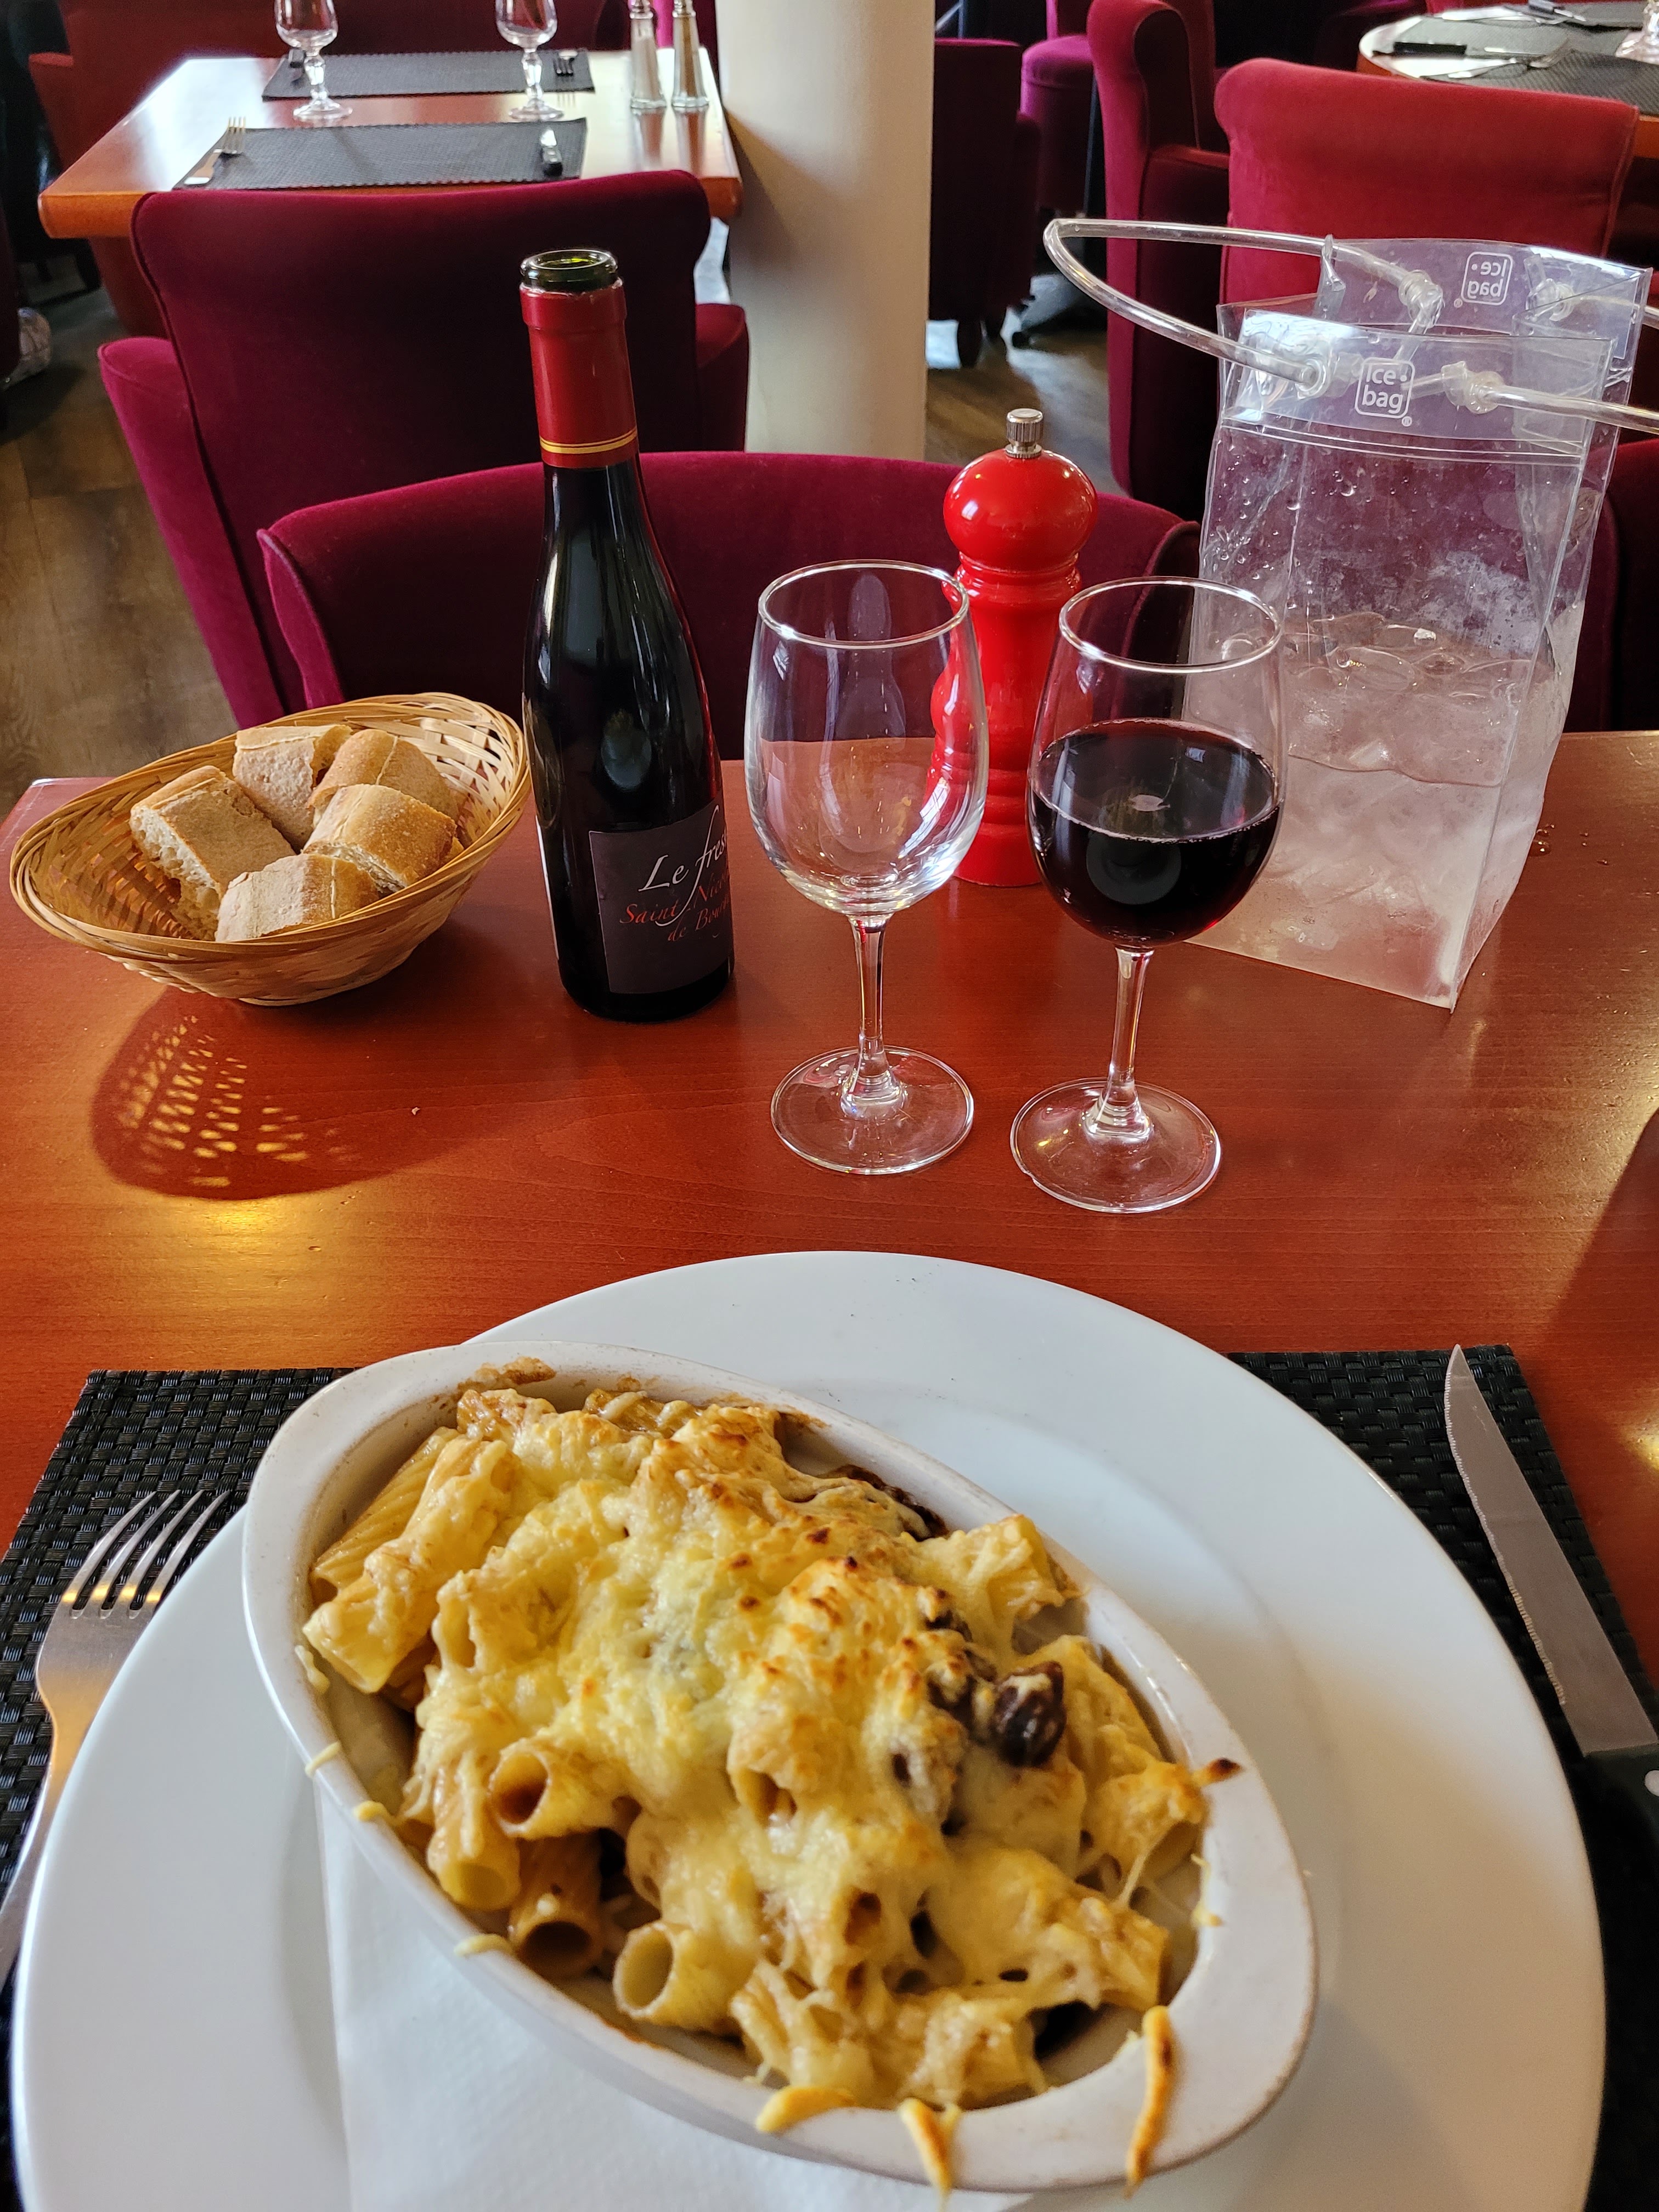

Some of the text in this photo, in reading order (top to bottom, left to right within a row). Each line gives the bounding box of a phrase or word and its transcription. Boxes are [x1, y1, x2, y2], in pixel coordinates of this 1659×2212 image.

[1362, 384, 1403, 414] bag
[637, 855, 689, 892] Le
[619, 899, 680, 924] Saint
[667, 908, 691, 942] de
